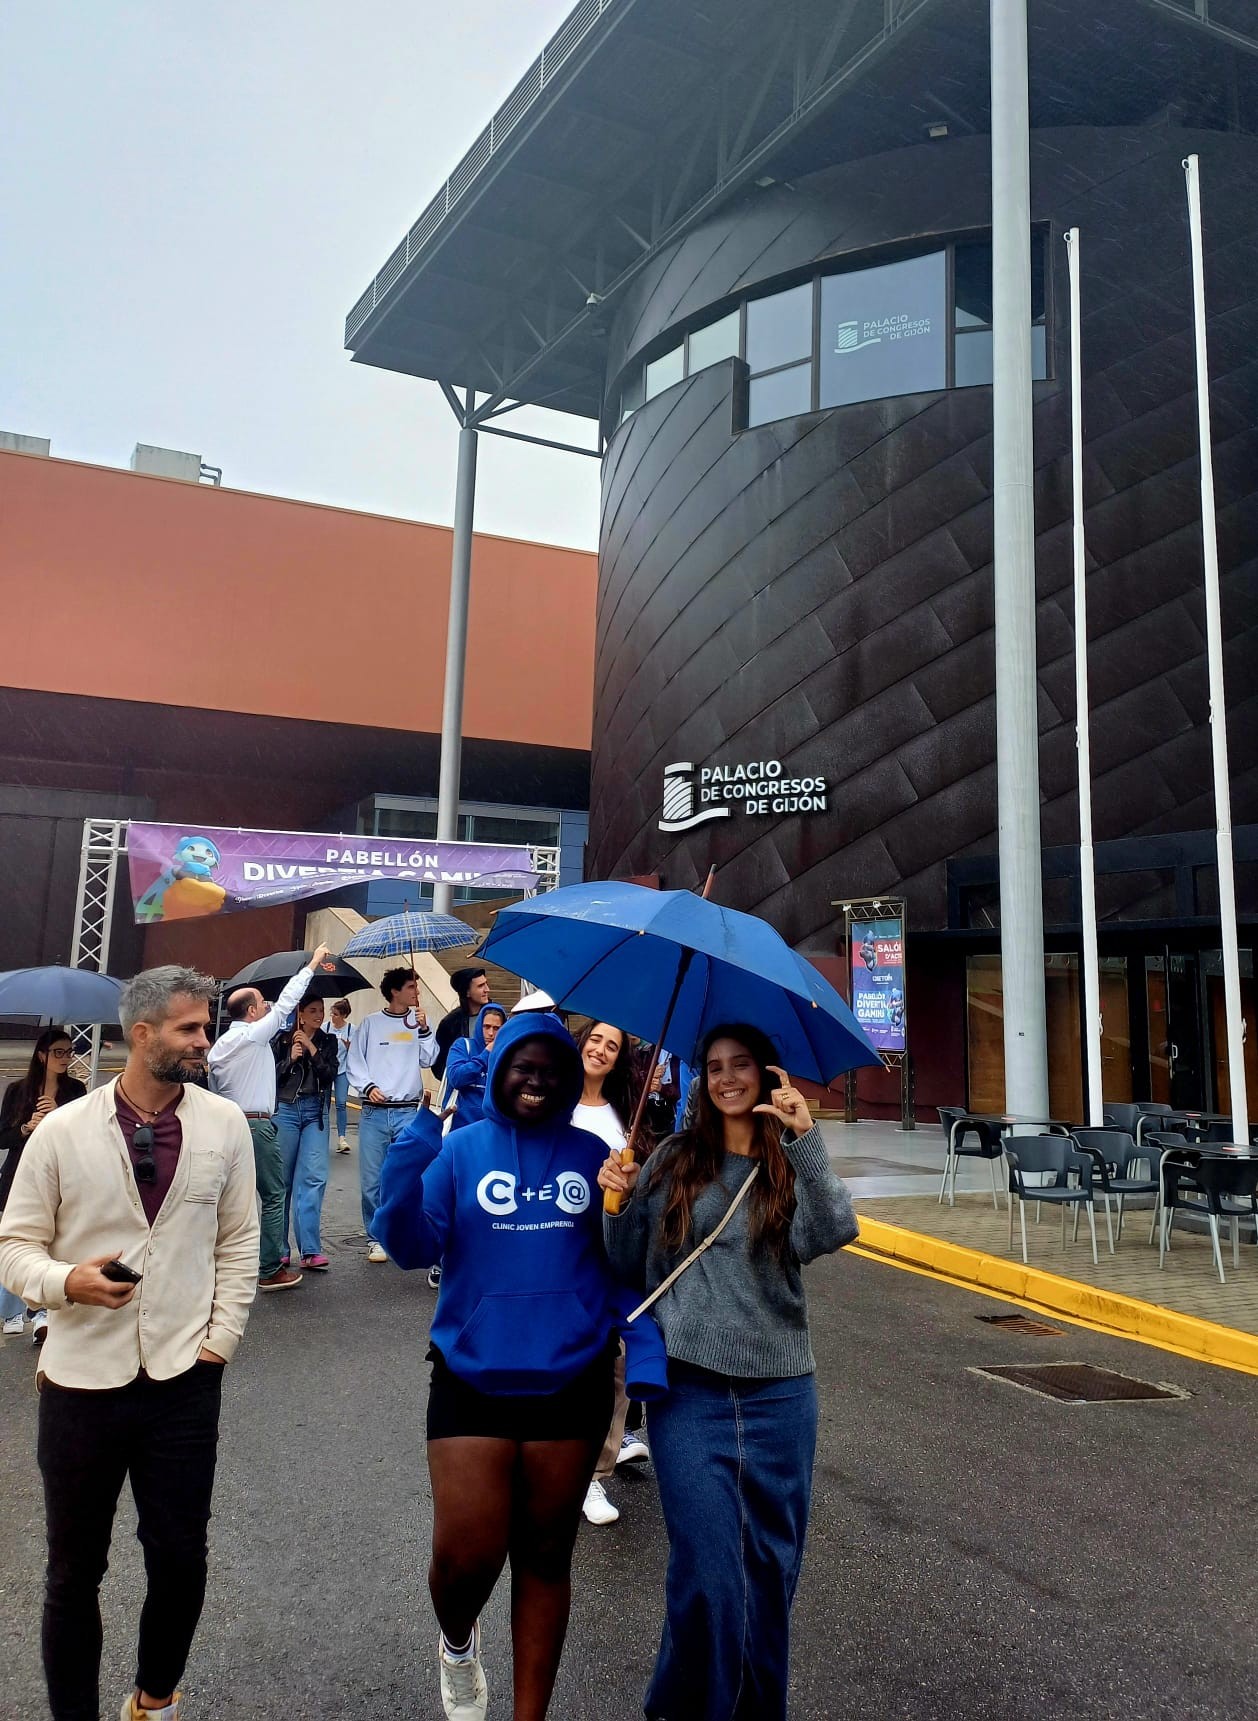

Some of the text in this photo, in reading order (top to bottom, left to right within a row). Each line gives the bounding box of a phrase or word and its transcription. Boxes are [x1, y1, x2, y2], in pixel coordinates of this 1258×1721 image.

[863, 314, 908, 331] PALACIO
[863, 318, 931, 338] DE CONGRESOS
[890, 332, 902, 340] DE
[701, 760, 782, 785] PALACIO
[701, 776, 827, 803] DE CONGRESOS
[746, 792, 827, 815] DE GIJÓN
[326, 849, 439, 868] PABELLÓN
[492, 1222, 515, 1231] CLINIC
[516, 1223, 539, 1231] JOVEN
